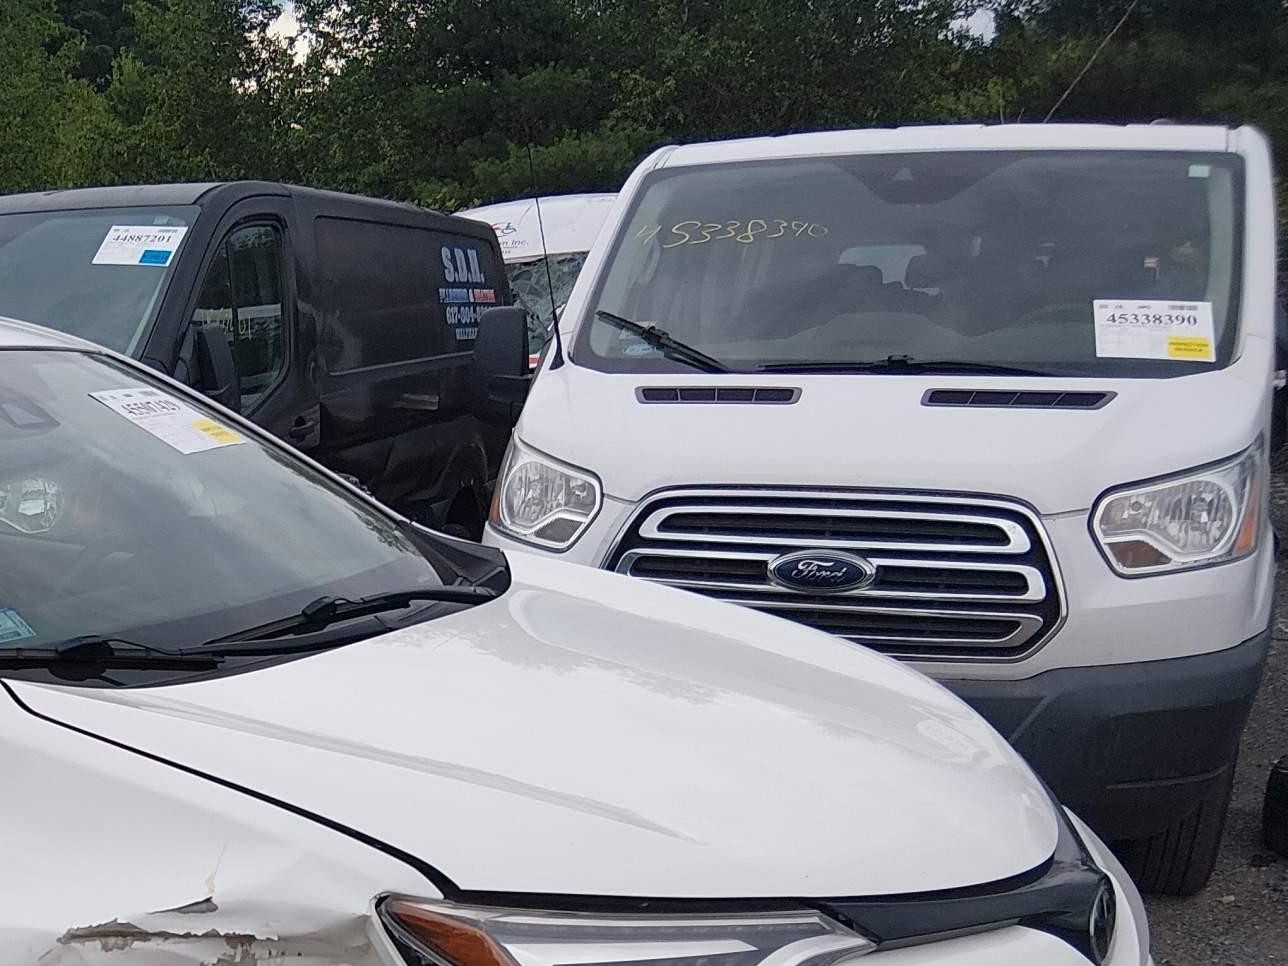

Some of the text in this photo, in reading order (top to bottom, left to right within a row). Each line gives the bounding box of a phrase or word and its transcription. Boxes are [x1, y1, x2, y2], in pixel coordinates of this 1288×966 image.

[112, 234, 172, 243] 44887201
[1106, 313, 1199, 326] 45338390
[791, 560, 848, 580] Ford
